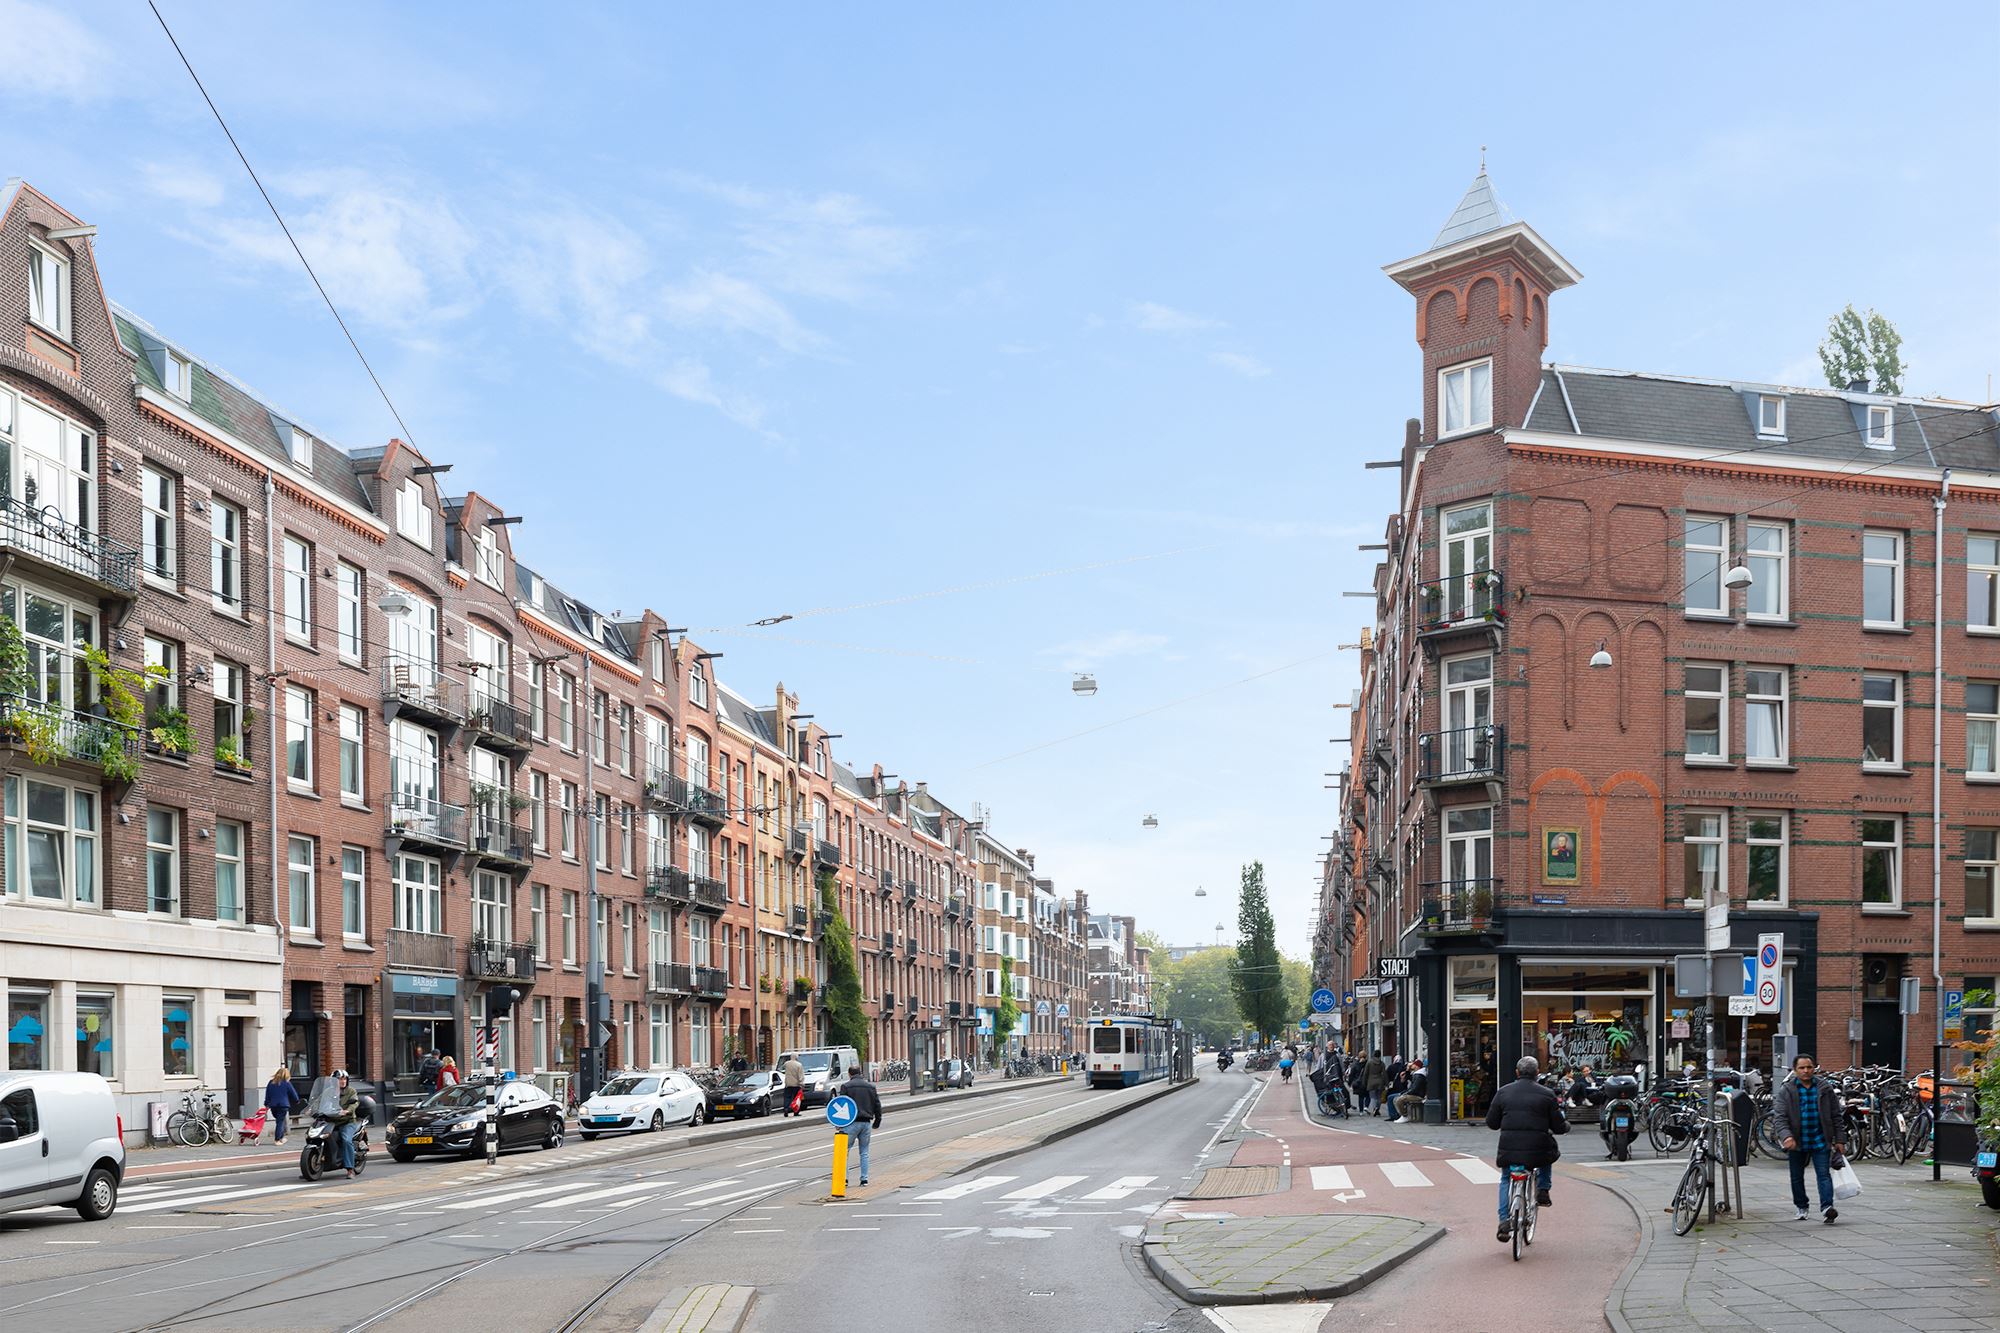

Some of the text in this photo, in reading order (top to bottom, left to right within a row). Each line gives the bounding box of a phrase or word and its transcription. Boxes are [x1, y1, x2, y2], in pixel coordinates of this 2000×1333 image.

[1381, 959, 1409, 975] STACH
[412, 976, 438, 987] BARBER
[1762, 989, 1773, 998] 30
[1948, 993, 1959, 1007] P
[1568, 1040, 1609, 1058] JACKFRUIT
